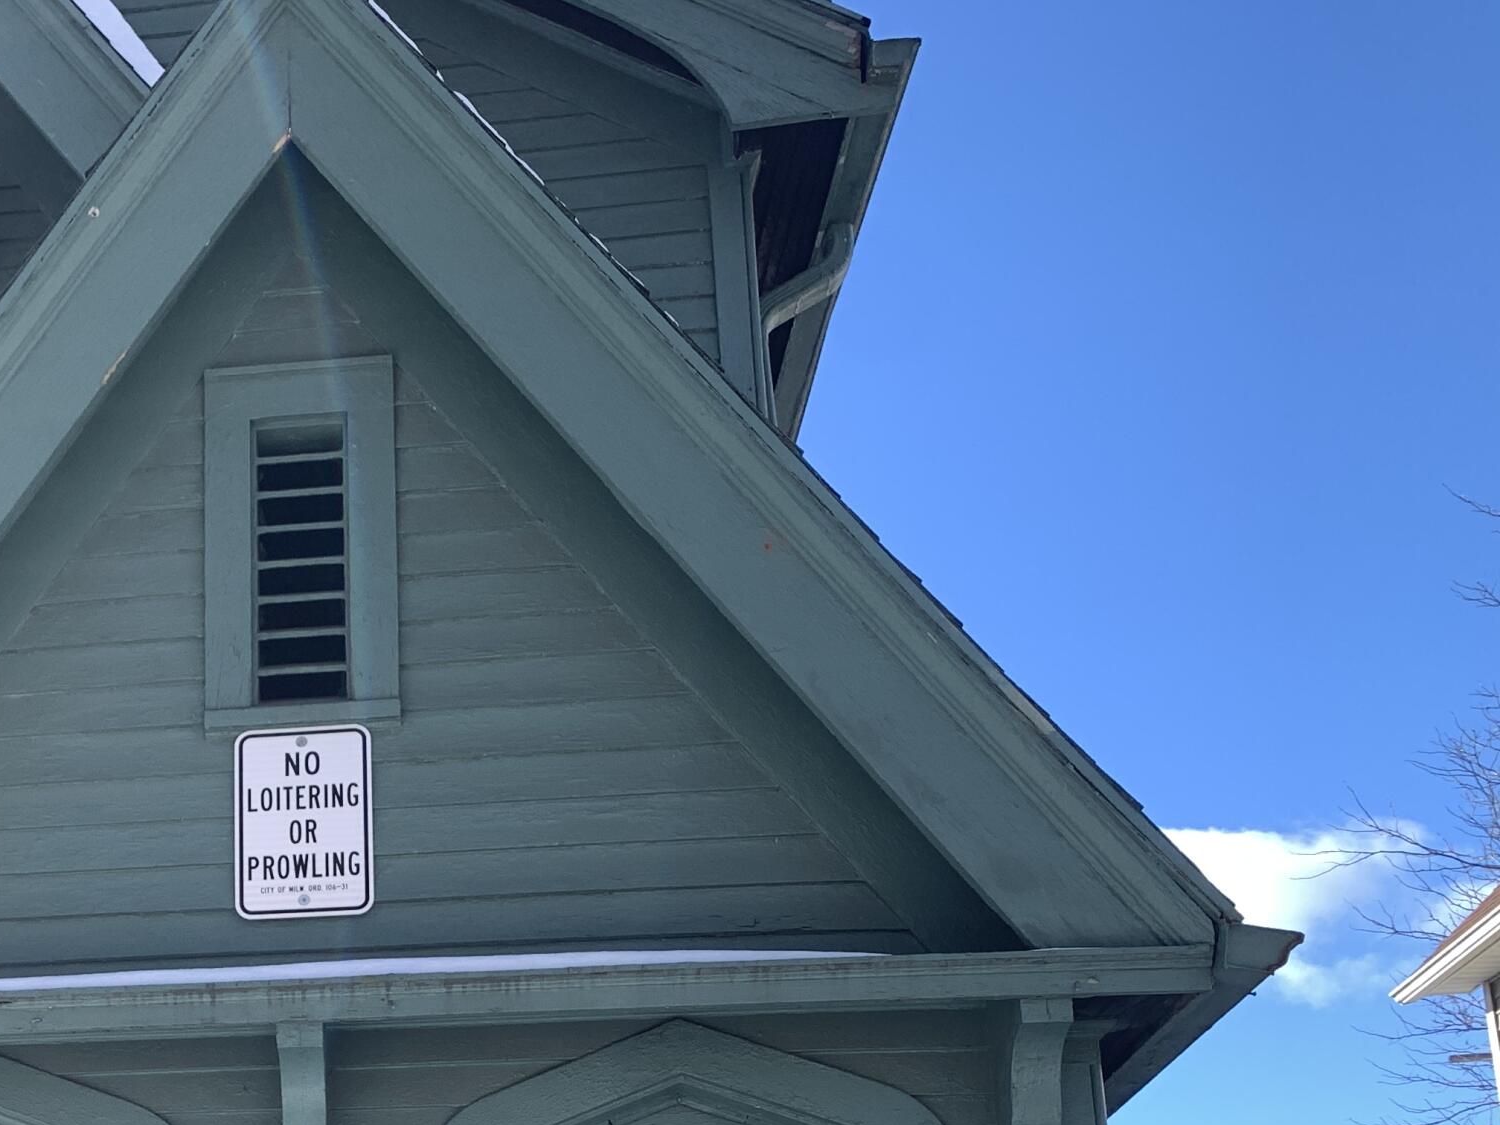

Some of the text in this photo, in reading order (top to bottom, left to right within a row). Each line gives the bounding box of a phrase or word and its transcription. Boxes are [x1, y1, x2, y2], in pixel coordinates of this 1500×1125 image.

[285, 751, 320, 777] NO
[247, 783, 359, 812] LOITERING
[289, 819, 317, 844] OR
[247, 851, 360, 881] PROWLING
